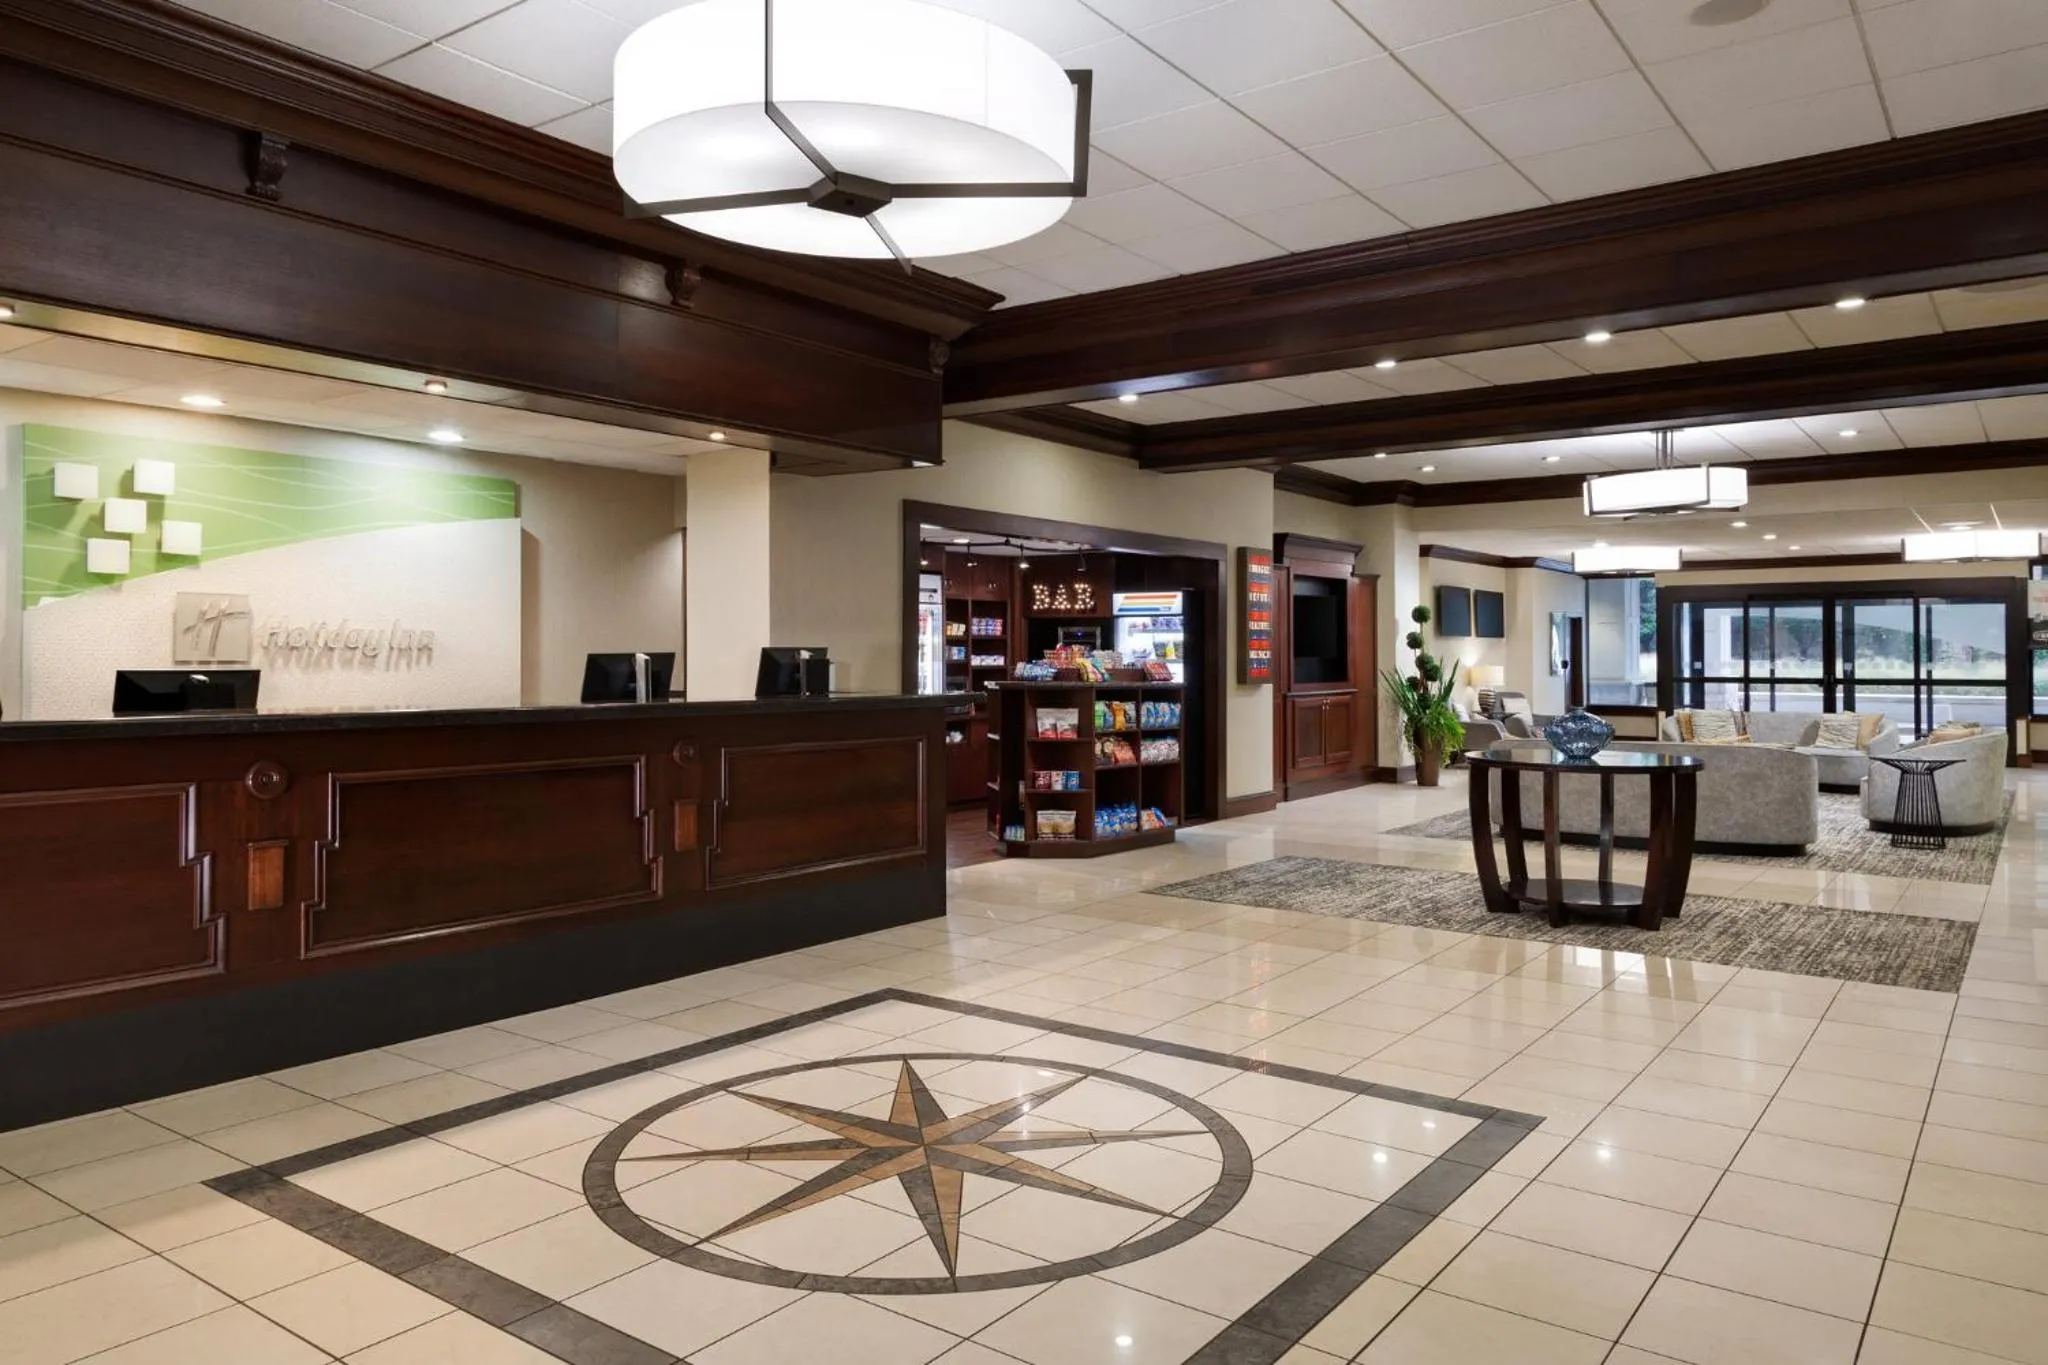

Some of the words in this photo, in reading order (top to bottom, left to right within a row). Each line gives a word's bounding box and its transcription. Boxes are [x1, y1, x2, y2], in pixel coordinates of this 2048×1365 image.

[1033, 583, 1095, 610] BAR
[261, 616, 385, 657] Holiday
[388, 618, 435, 651] Inn
